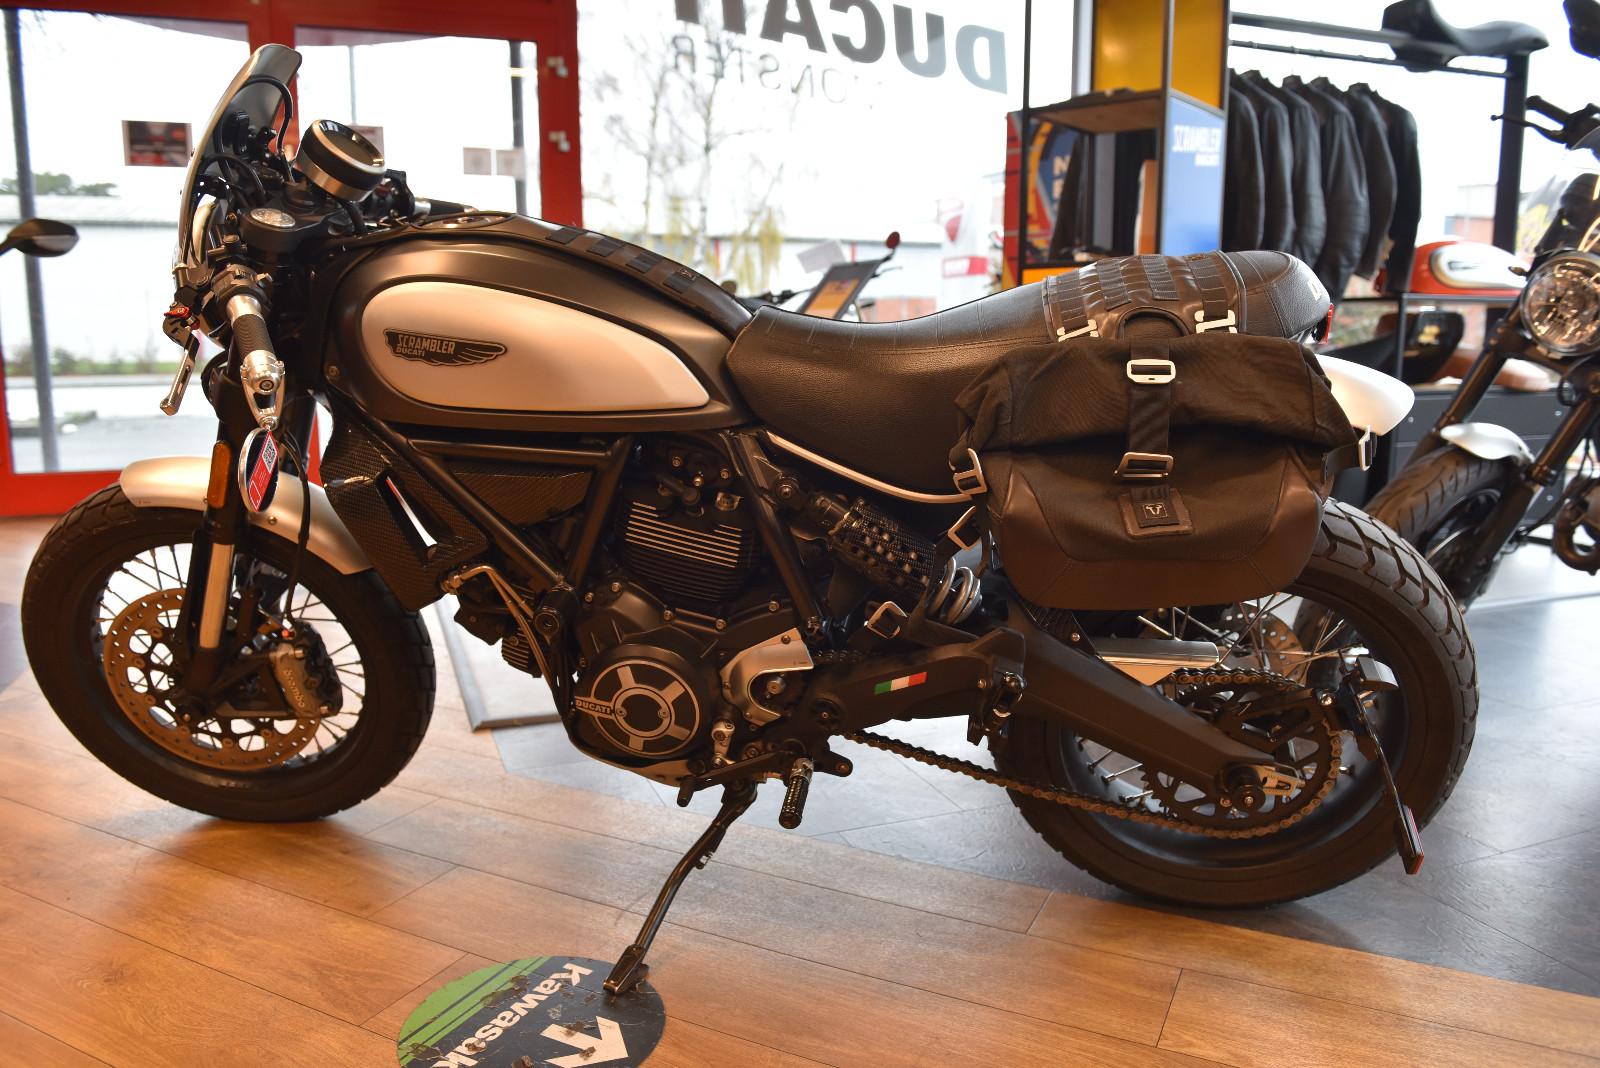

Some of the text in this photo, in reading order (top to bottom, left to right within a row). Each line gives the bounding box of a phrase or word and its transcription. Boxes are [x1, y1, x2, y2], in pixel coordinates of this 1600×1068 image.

[396, 346, 426, 357] DUCATI
[397, 333, 456, 355] SCRAMBLER
[576, 699, 612, 714] DUCATI
[430, 962, 593, 1068] Kawasak
